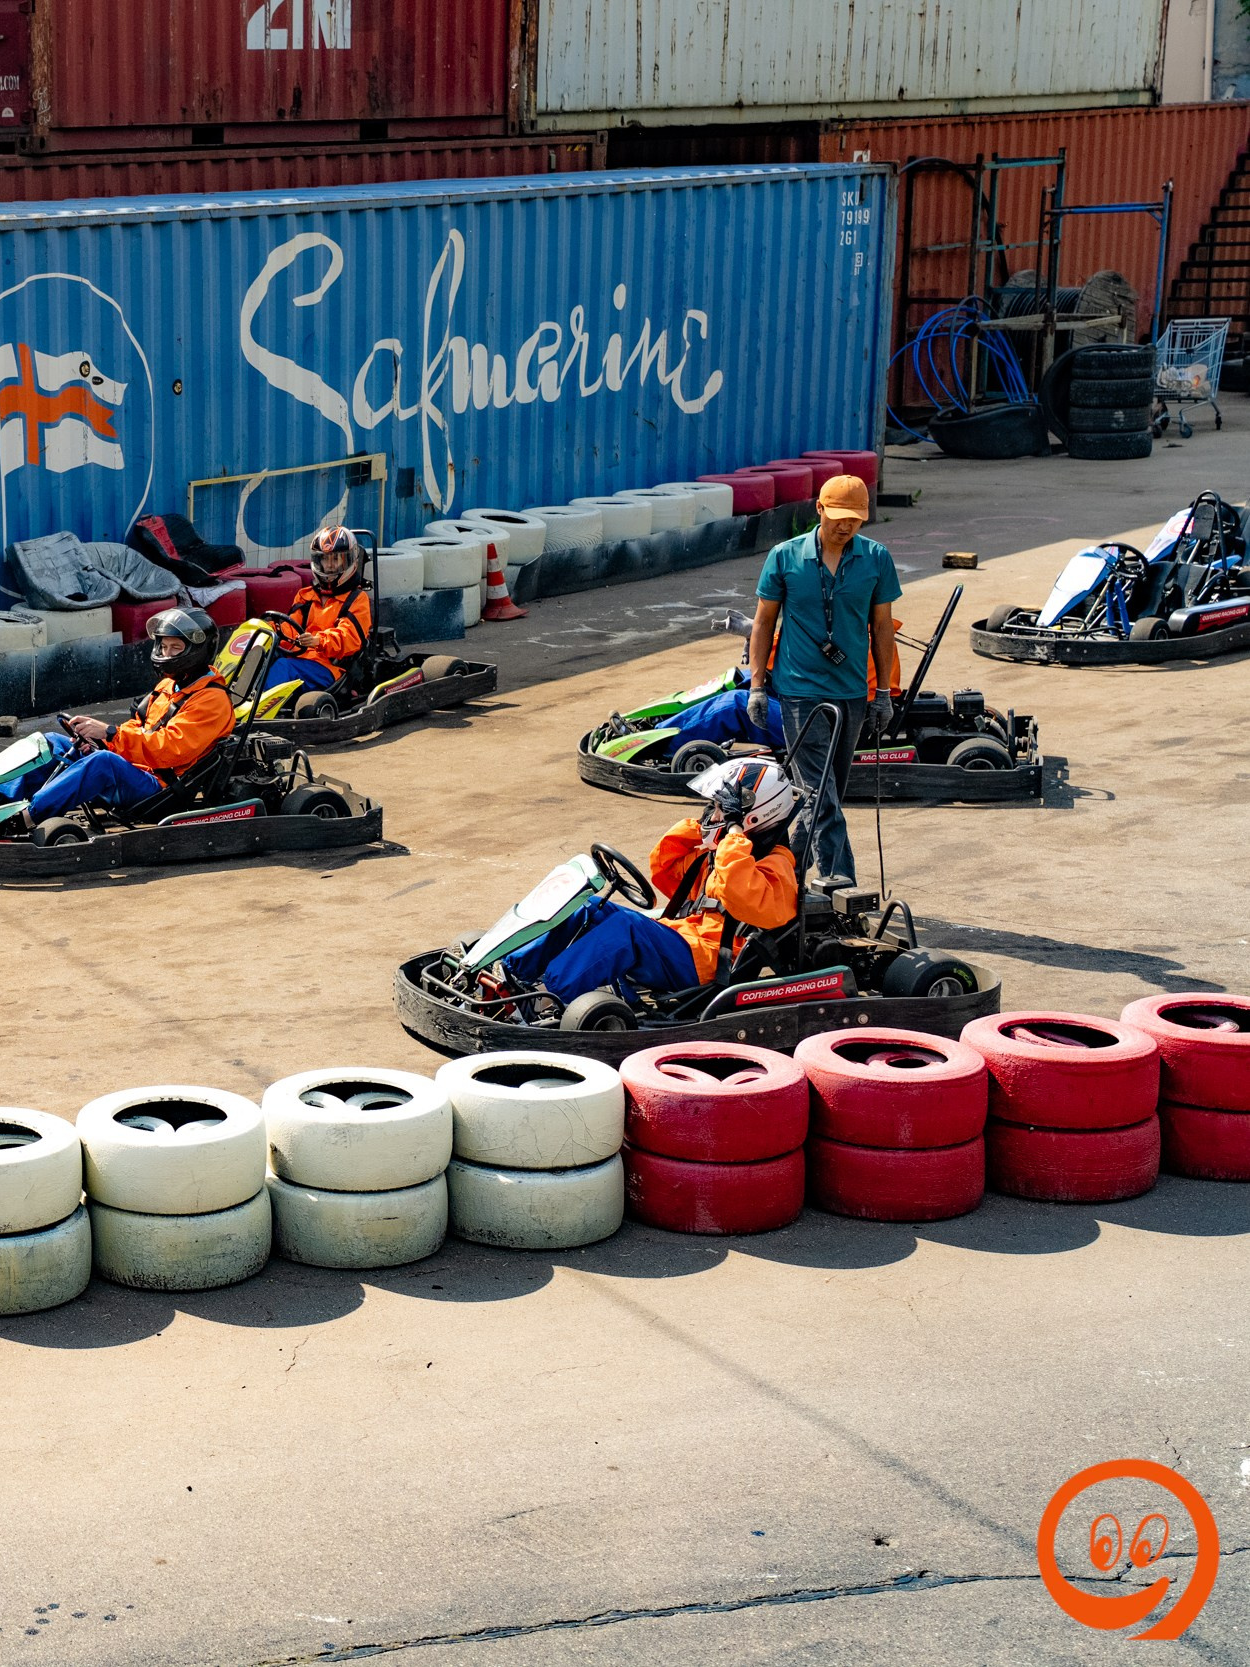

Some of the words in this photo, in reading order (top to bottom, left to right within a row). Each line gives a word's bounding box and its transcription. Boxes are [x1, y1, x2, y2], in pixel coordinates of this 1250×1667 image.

[236, 228, 723, 567] Safmarine
[861, 753, 888, 761] RACNG
[889, 752, 909, 760] CLUB
[234, 808, 251, 818] CLUB
[785, 981, 816, 995] RACING
[817, 977, 838, 988] CLUB
